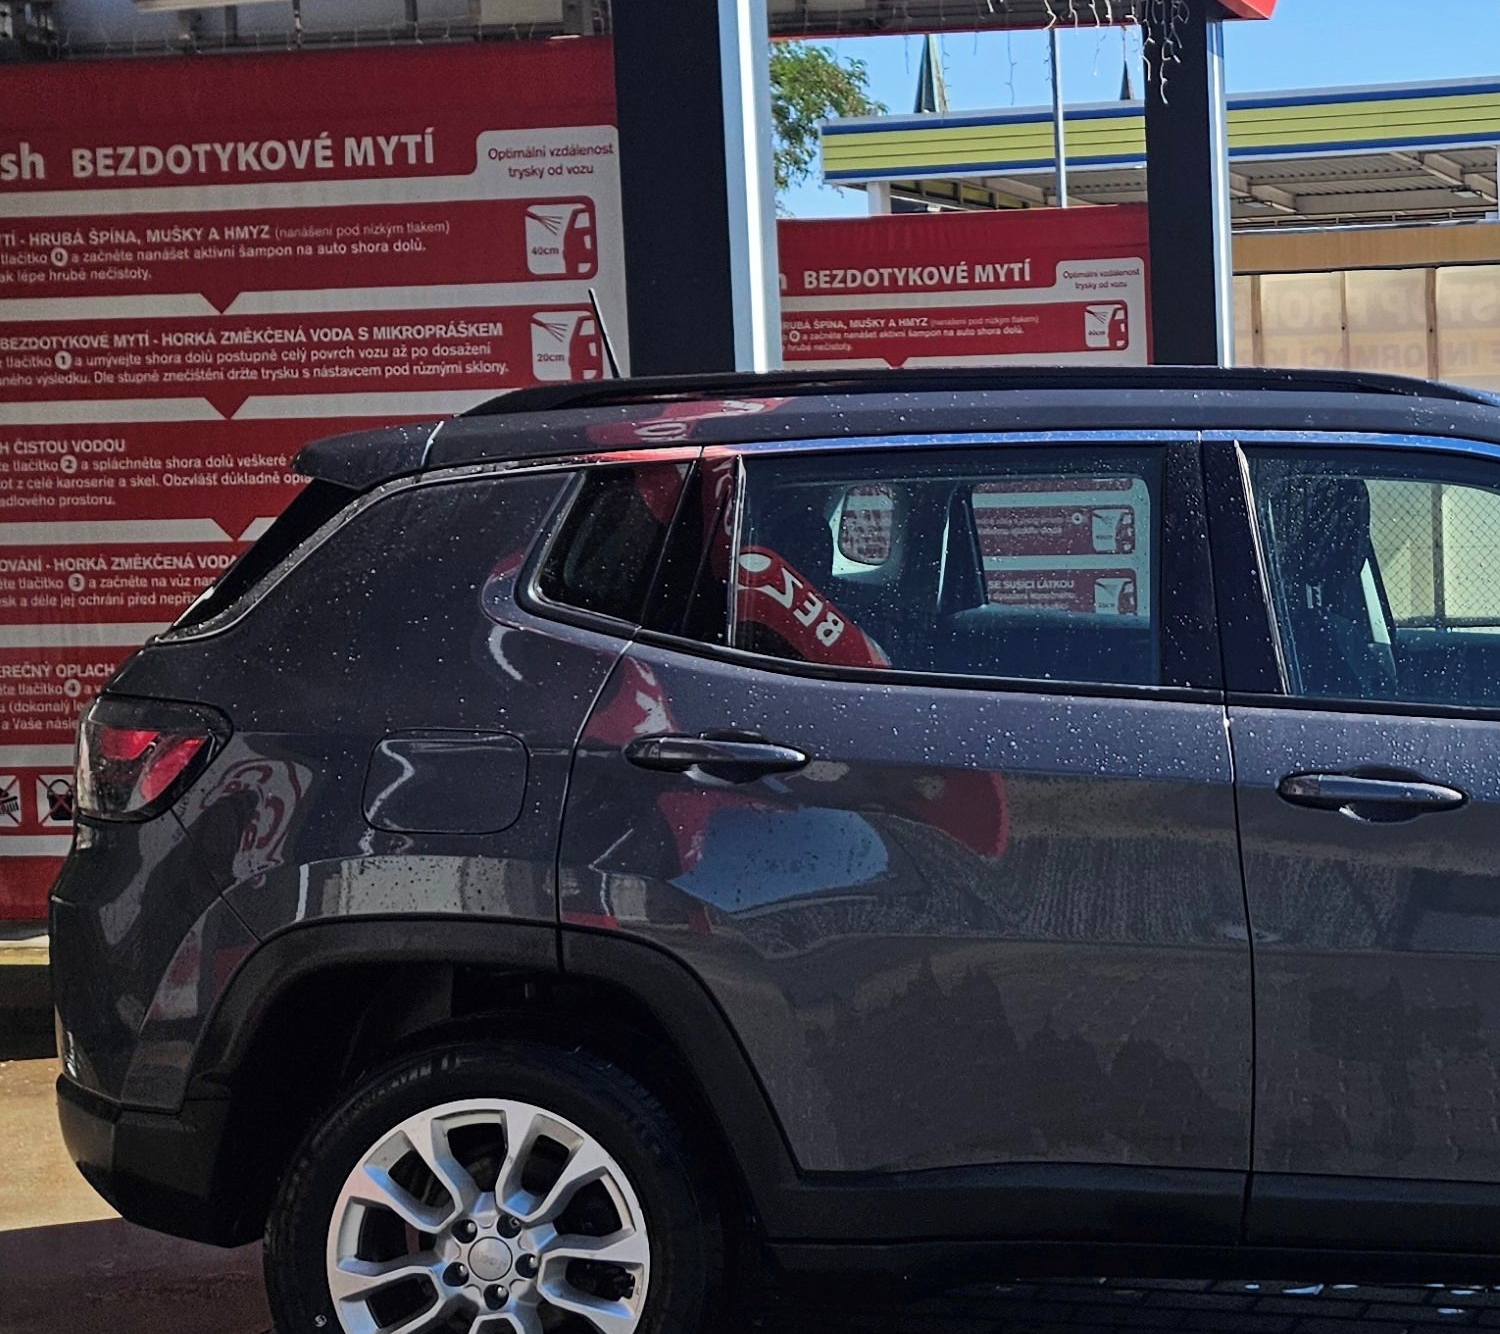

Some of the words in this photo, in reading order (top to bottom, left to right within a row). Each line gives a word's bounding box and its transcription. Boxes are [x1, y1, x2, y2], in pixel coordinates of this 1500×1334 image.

[71, 131, 334, 178] BEZDOTYKOVÉ
[344, 127, 435, 167] MYTÍ
[488, 147, 546, 160] Optimální
[550, 143, 614, 157] vzdálenost
[508, 166, 544, 179] trysky
[547, 164, 563, 176] od
[567, 165, 594, 175] vozu
[29, 228, 84, 246] HRUBÁ
[89, 226, 141, 244] ŠPÍNA,
[146, 224, 202, 243] MUŠKY
[208, 227, 220, 240] A
[224, 225, 270, 240] HMYZ
[336, 221, 360, 239] pod
[407, 220, 450, 235] tlakem)
[71, 253, 79, 263] a
[137, 246, 189, 261] nanášet
[239, 243, 292, 260] šampon
[296, 244, 313, 255] na
[317, 243, 347, 255] auto
[351, 240, 389, 253] shora
[393, 238, 426, 252] dolů.
[531, 246, 559, 255] 40cm
[49, 269, 86, 281] hrubé
[804, 261, 969, 289] BEZDOTYKOVÉ
[975, 258, 1031, 283] MYTÍ
[0, 331, 109, 350] BEZDOTYKOVÉ
[113, 329, 149, 348] MYTÍ
[162, 327, 216, 346] HORKÁ
[220, 326, 306, 344] ZMĚKČENÁ
[310, 326, 354, 342] VODA
[358, 326, 369, 340] S
[372, 320, 502, 339] MIKROPRÁŠKEM
[74, 357, 82, 366] a
[86, 352, 141, 368] umývejte
[145, 351, 181, 365] shora
[185, 350, 213, 363] dolů
[217, 350, 277, 366] postupně
[281, 347, 307, 364] celý
[311, 346, 354, 361] povrch
[358, 347, 388, 358] vozu
[392, 343, 407, 357] až
[411, 346, 428, 360] po
[432, 341, 491, 356] dosažení
[537, 353, 565, 363] 20cm
[94, 370, 115, 383] Dle
[117, 369, 160, 385] stupně
[261, 366, 299, 382] trysku
[313, 364, 381, 379] nástavcem
[385, 362, 409, 378] pod
[413, 360, 462, 377] různými
[465, 359, 509, 375] sklony.
[13, 438, 67, 454] ČISTOU
[71, 439, 125, 454] VODOU
[81, 460, 89, 470] a
[165, 455, 201, 469] shora
[205, 454, 233, 468] dolů
[237, 453, 287, 467] veškeré
[56, 475, 114, 488] karoserie
[118, 477, 126, 488] a
[129, 474, 159, 487] skel.
[59, 492, 116, 507] prostoru.
[53, 553, 107, 571] HORKÁ
[111, 553, 195, 569] ZMĚKČENÁ
[88, 578, 97, 589] a
[100, 574, 147, 588] začněte
[151, 576, 167, 588] na
[169, 573, 191, 587] vůz
[60, 592, 75, 609] jej
[78, 591, 124, 606] ochrání
[128, 591, 156, 606] před
[55, 663, 115, 677] OPLACH
[12, 717, 42, 729] Vaše
